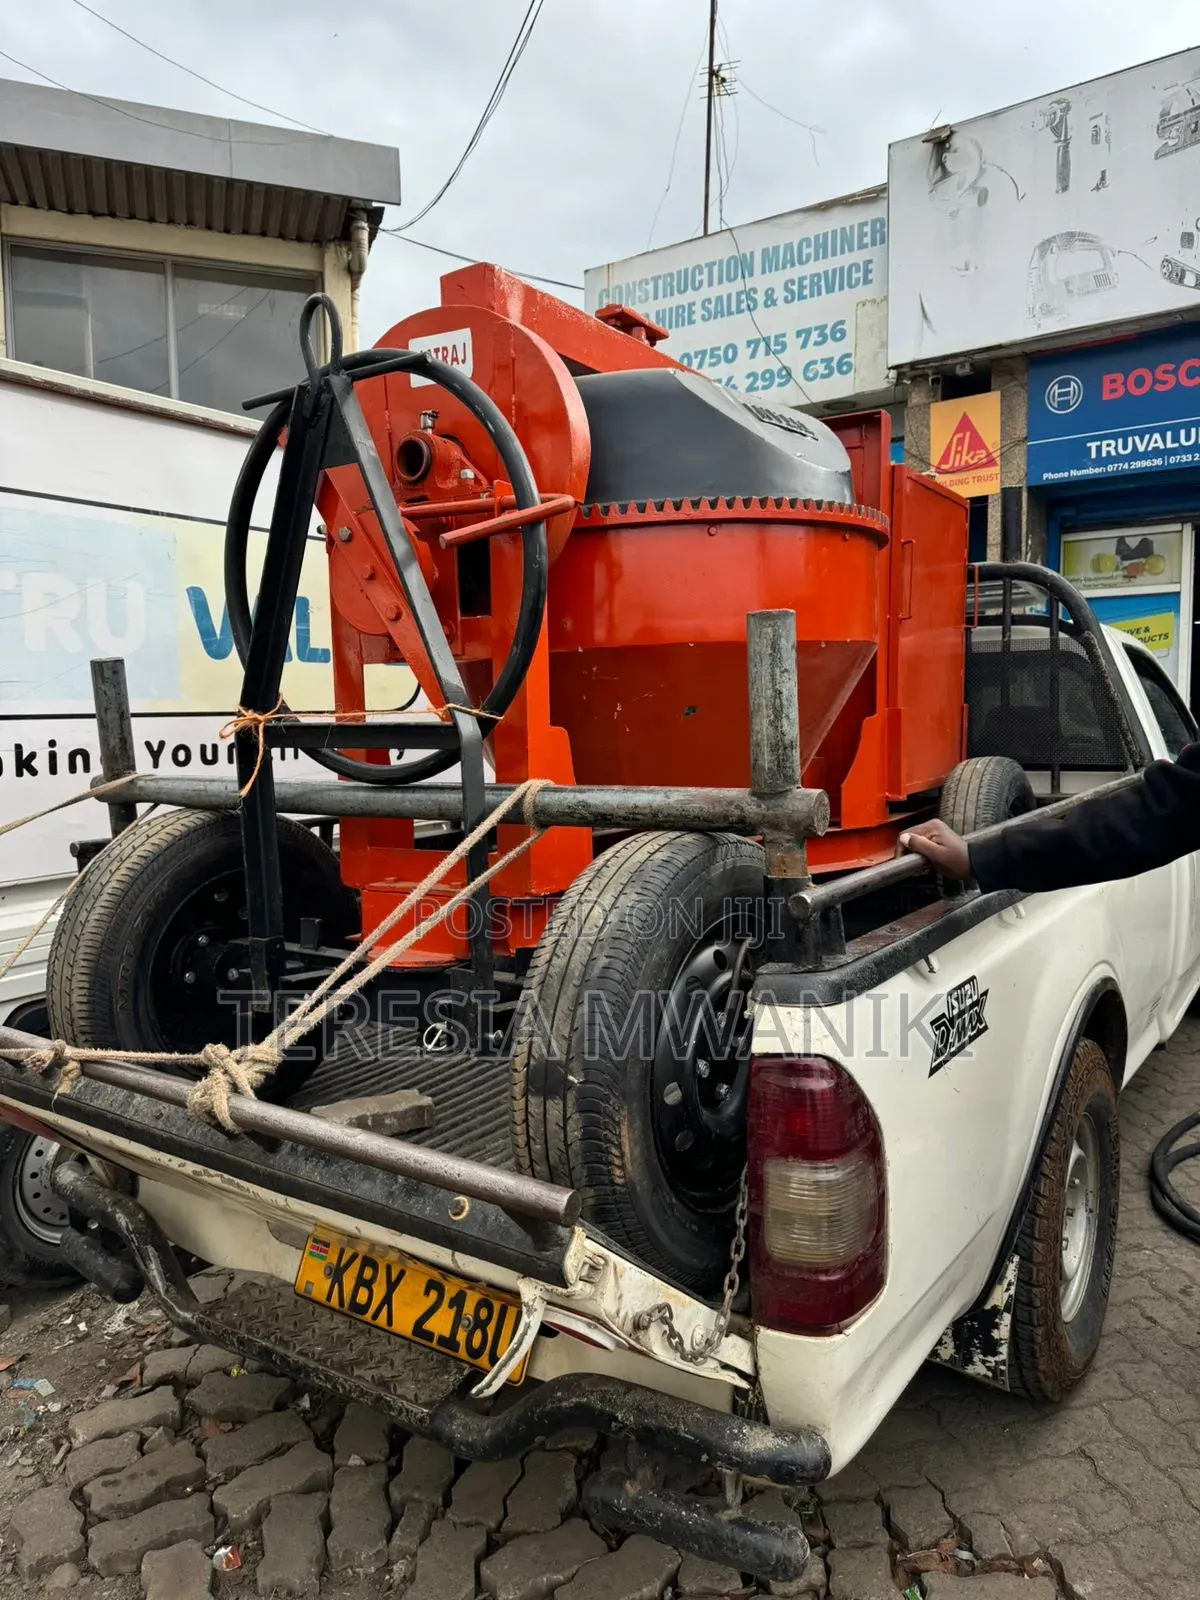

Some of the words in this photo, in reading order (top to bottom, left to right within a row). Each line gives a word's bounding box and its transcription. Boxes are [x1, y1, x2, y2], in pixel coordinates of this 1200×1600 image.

[597, 250, 755, 308] CONSTRUCTION
[761, 216, 886, 275] MACHINER
[655, 301, 697, 331] HIRE
[701, 286, 759, 322] SALES
[764, 287, 778, 309] &
[783, 258, 874, 304] SERVICE
[420, 342, 467, 366] TRAJ
[678, 342, 738, 371] 0750
[746, 332, 787, 360] 715
[795, 319, 847, 350] 736
[745, 366, 792, 393] 299
[802, 353, 854, 383] 636
[1102, 358, 1200, 401] BOSC
[941, 431, 988, 470] Sika
[1087, 427, 1200, 458] TRUVALU
[971, 472, 999, 484] TRUST
[1043, 471, 1069, 481] Phone
[1070, 466, 1106, 477] Number:
[1107, 462, 1129, 472] 0774
[1130, 457, 1163, 470] 299636
[1169, 453, 1193, 464] 0733
[0, 570, 146, 658] RU
[0, 739, 102, 778] kin
[947, 979, 979, 1018] ISUZU
[326, 1247, 407, 1328] KBX
